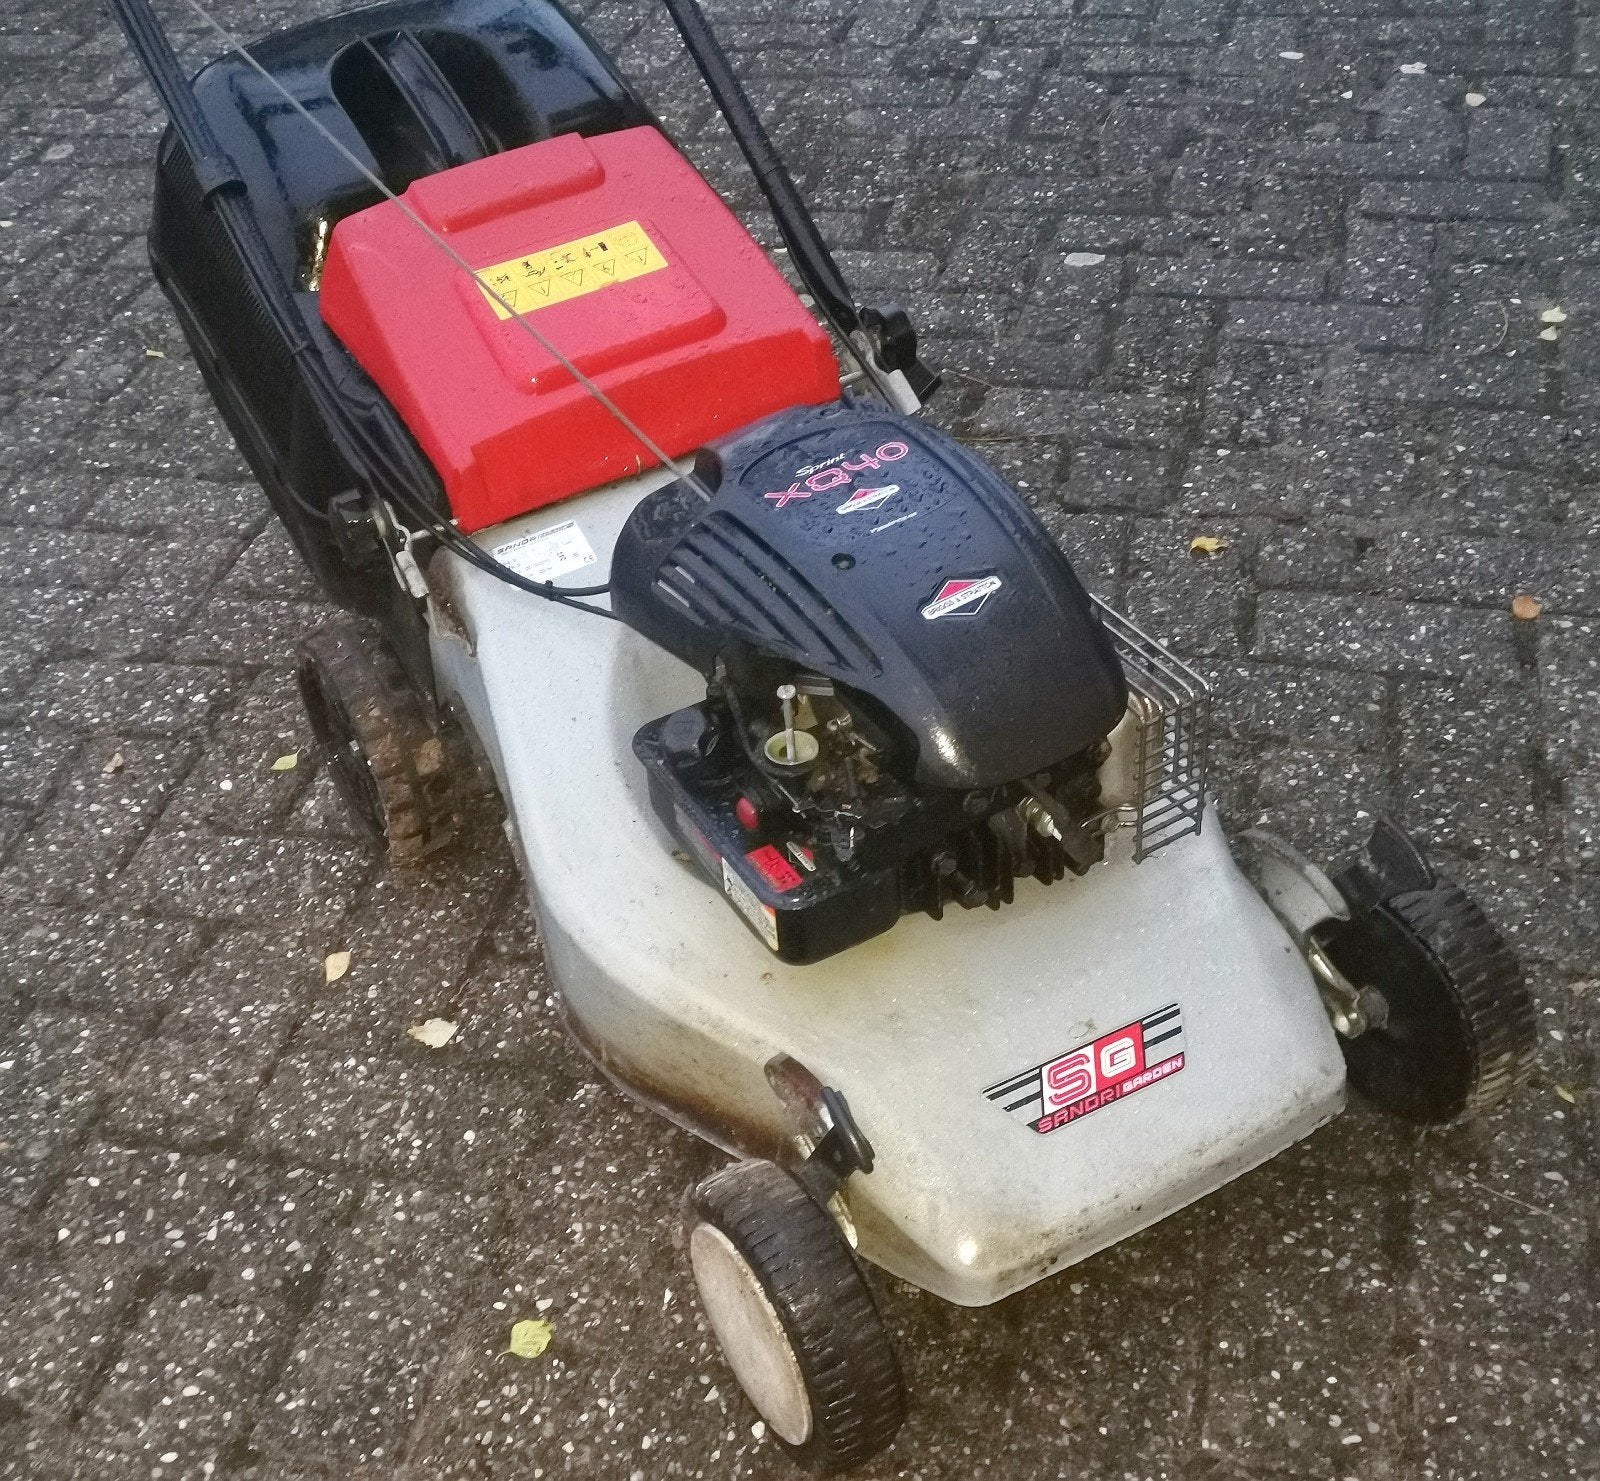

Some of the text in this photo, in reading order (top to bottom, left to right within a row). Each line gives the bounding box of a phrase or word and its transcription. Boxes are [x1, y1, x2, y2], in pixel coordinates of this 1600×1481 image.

[764, 441, 909, 508] XQ40
[795, 452, 847, 477] Sprint
[1037, 1056, 1184, 1133] SANDRI GARDEN
[1047, 1037, 1136, 1106] SG
